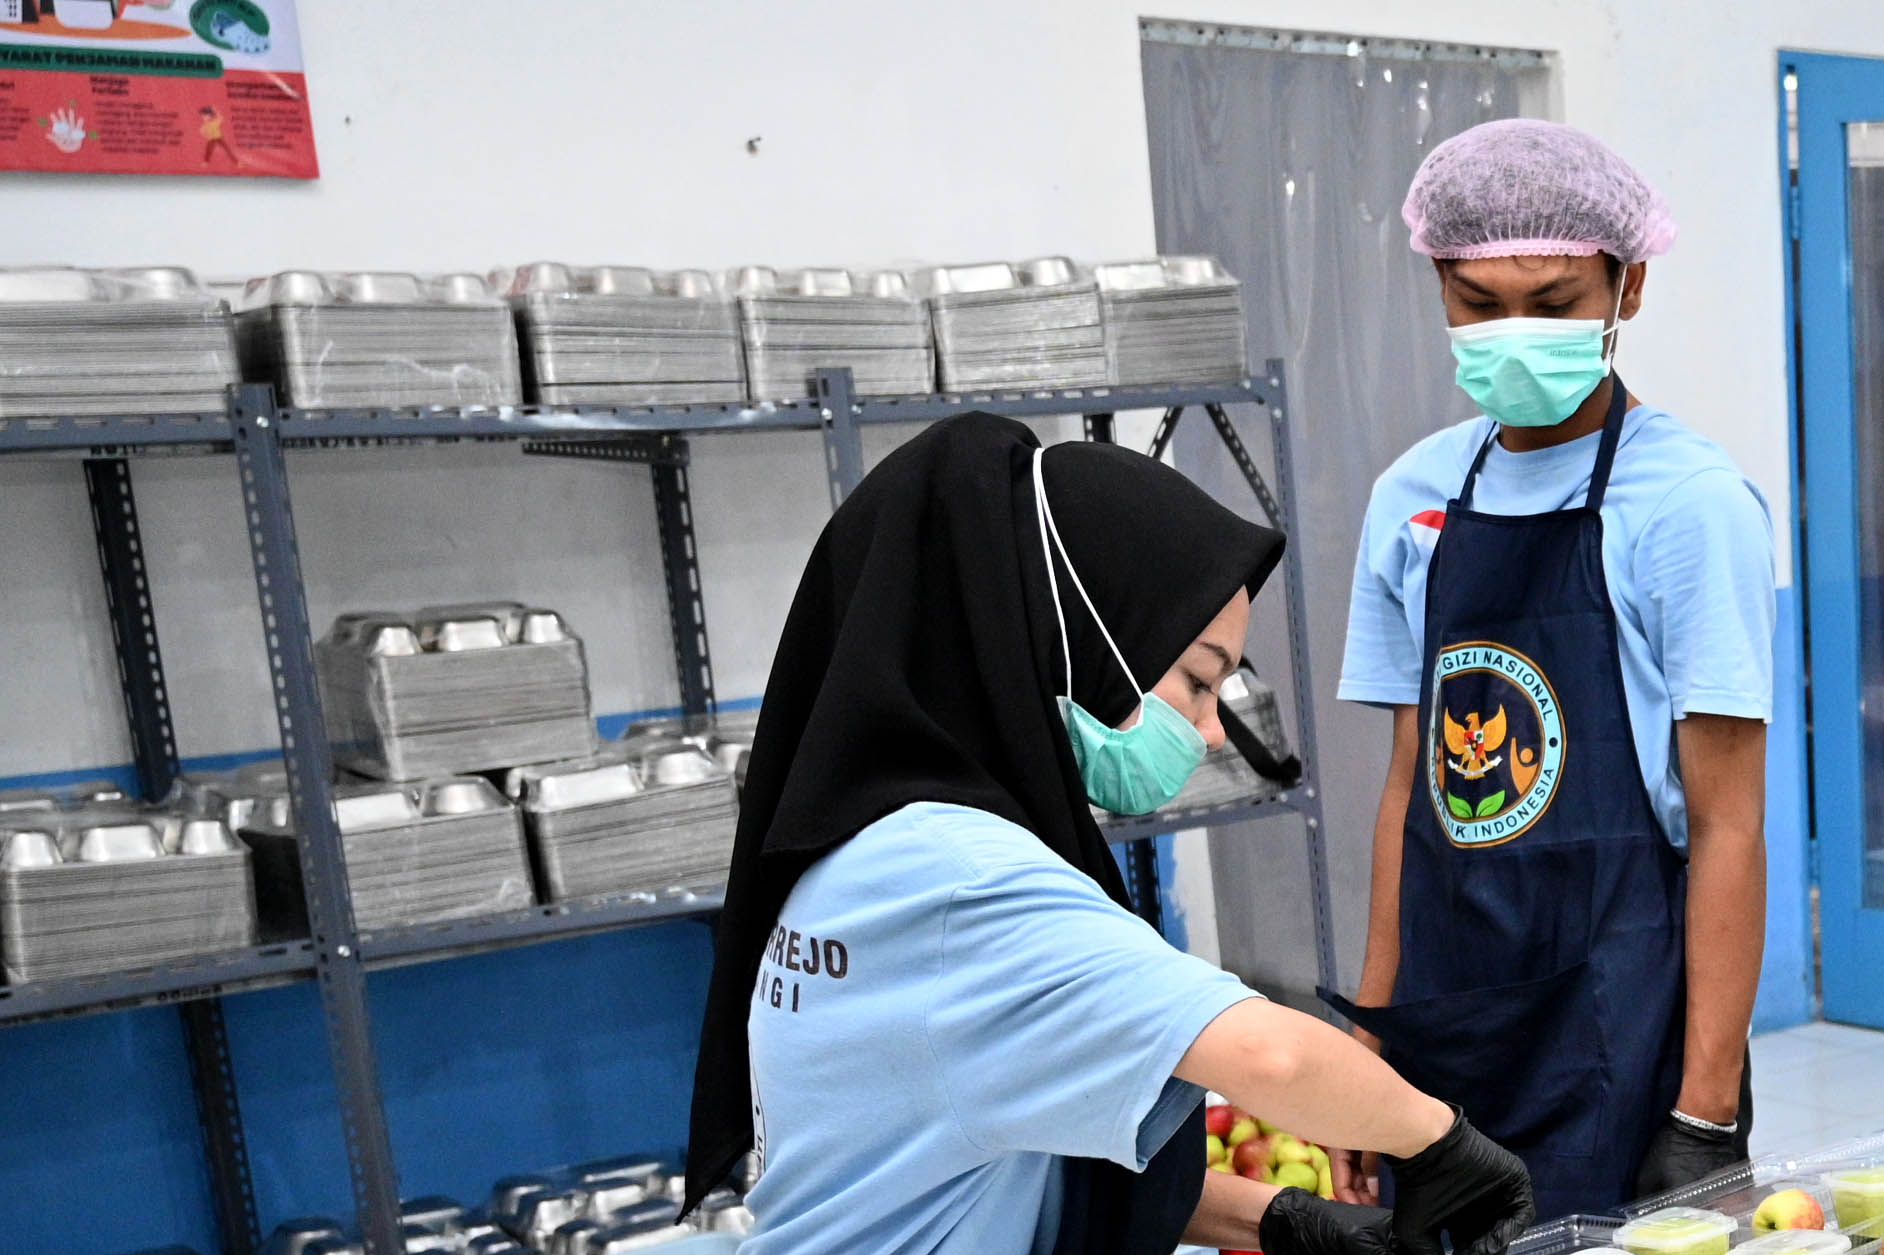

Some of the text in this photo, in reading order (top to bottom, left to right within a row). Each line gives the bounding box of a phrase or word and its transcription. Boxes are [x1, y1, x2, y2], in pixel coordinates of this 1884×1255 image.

[1442, 652, 1477, 670] GIZI
[1483, 651, 1553, 721] NASIONAL
[1474, 767, 1555, 839] INDONESIA
